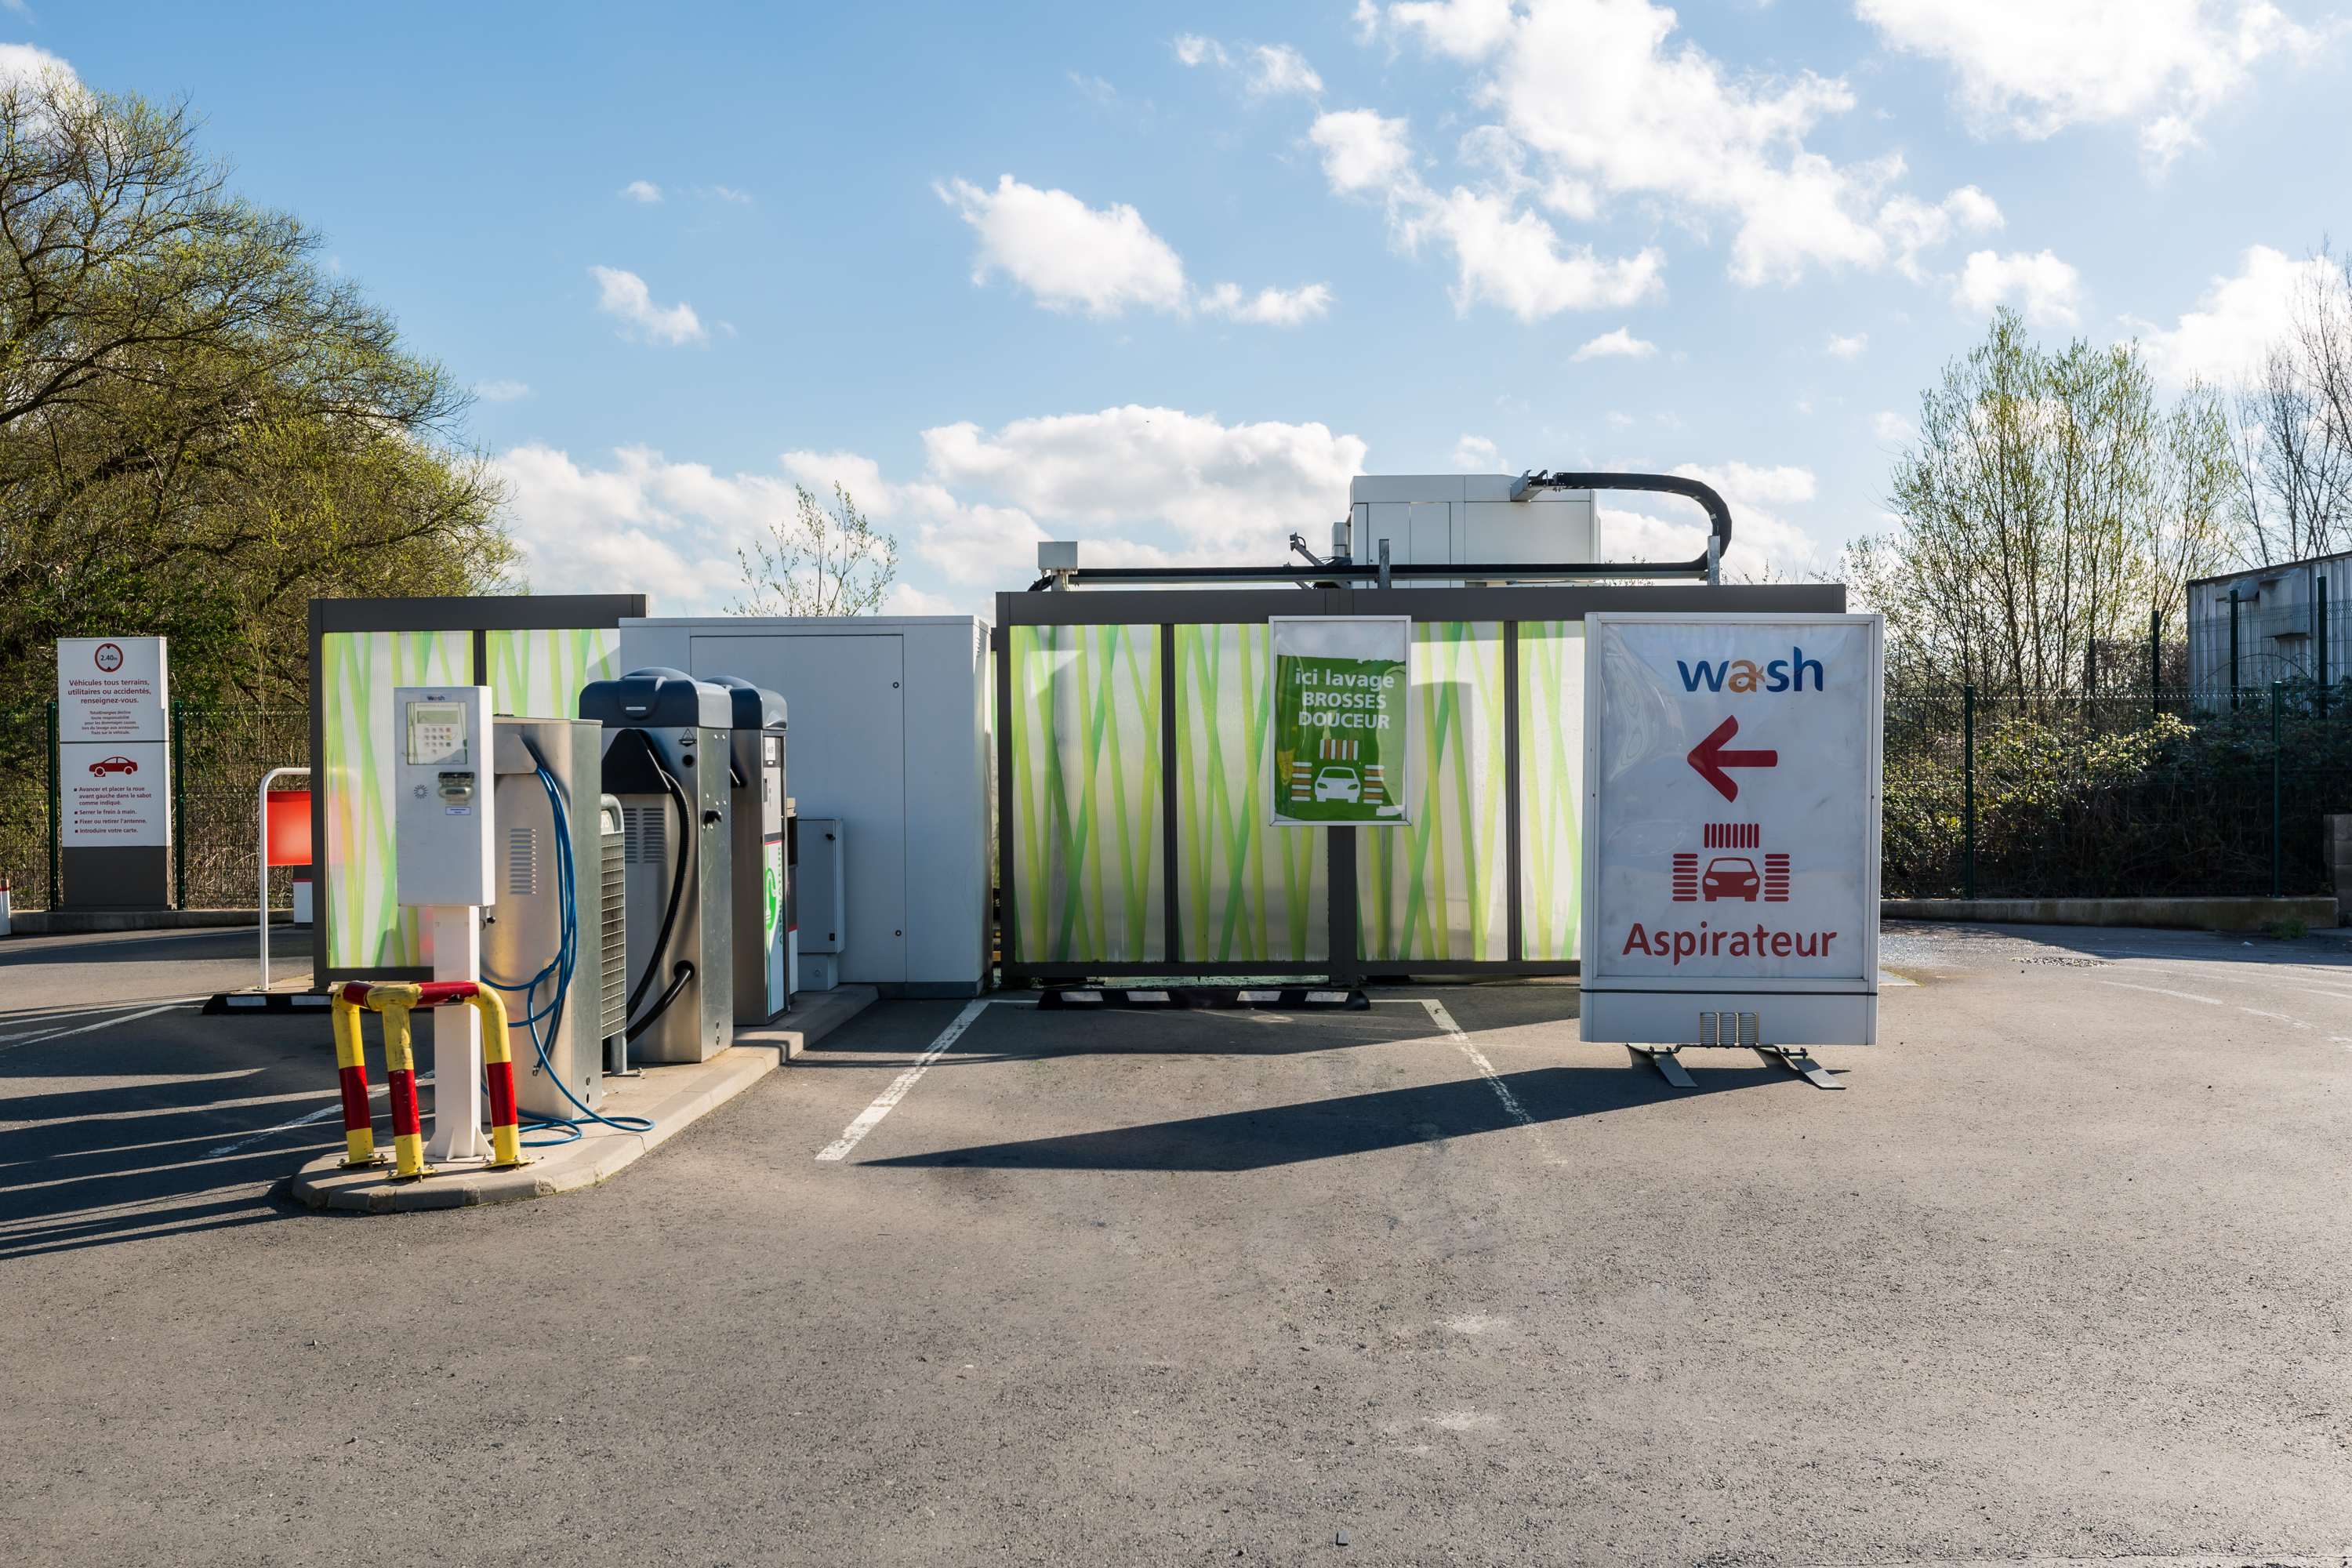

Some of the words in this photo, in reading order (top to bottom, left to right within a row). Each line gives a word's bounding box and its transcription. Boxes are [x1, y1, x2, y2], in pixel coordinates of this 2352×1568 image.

[1295, 668, 1318, 685] ici
[1326, 669, 1395, 691] lavage
[1677, 646, 1824, 693] wash
[1303, 691, 1387, 710] BROSSES
[1298, 711, 1390, 729] DOUCEUR
[1622, 921, 1837, 965] Aspirateur
